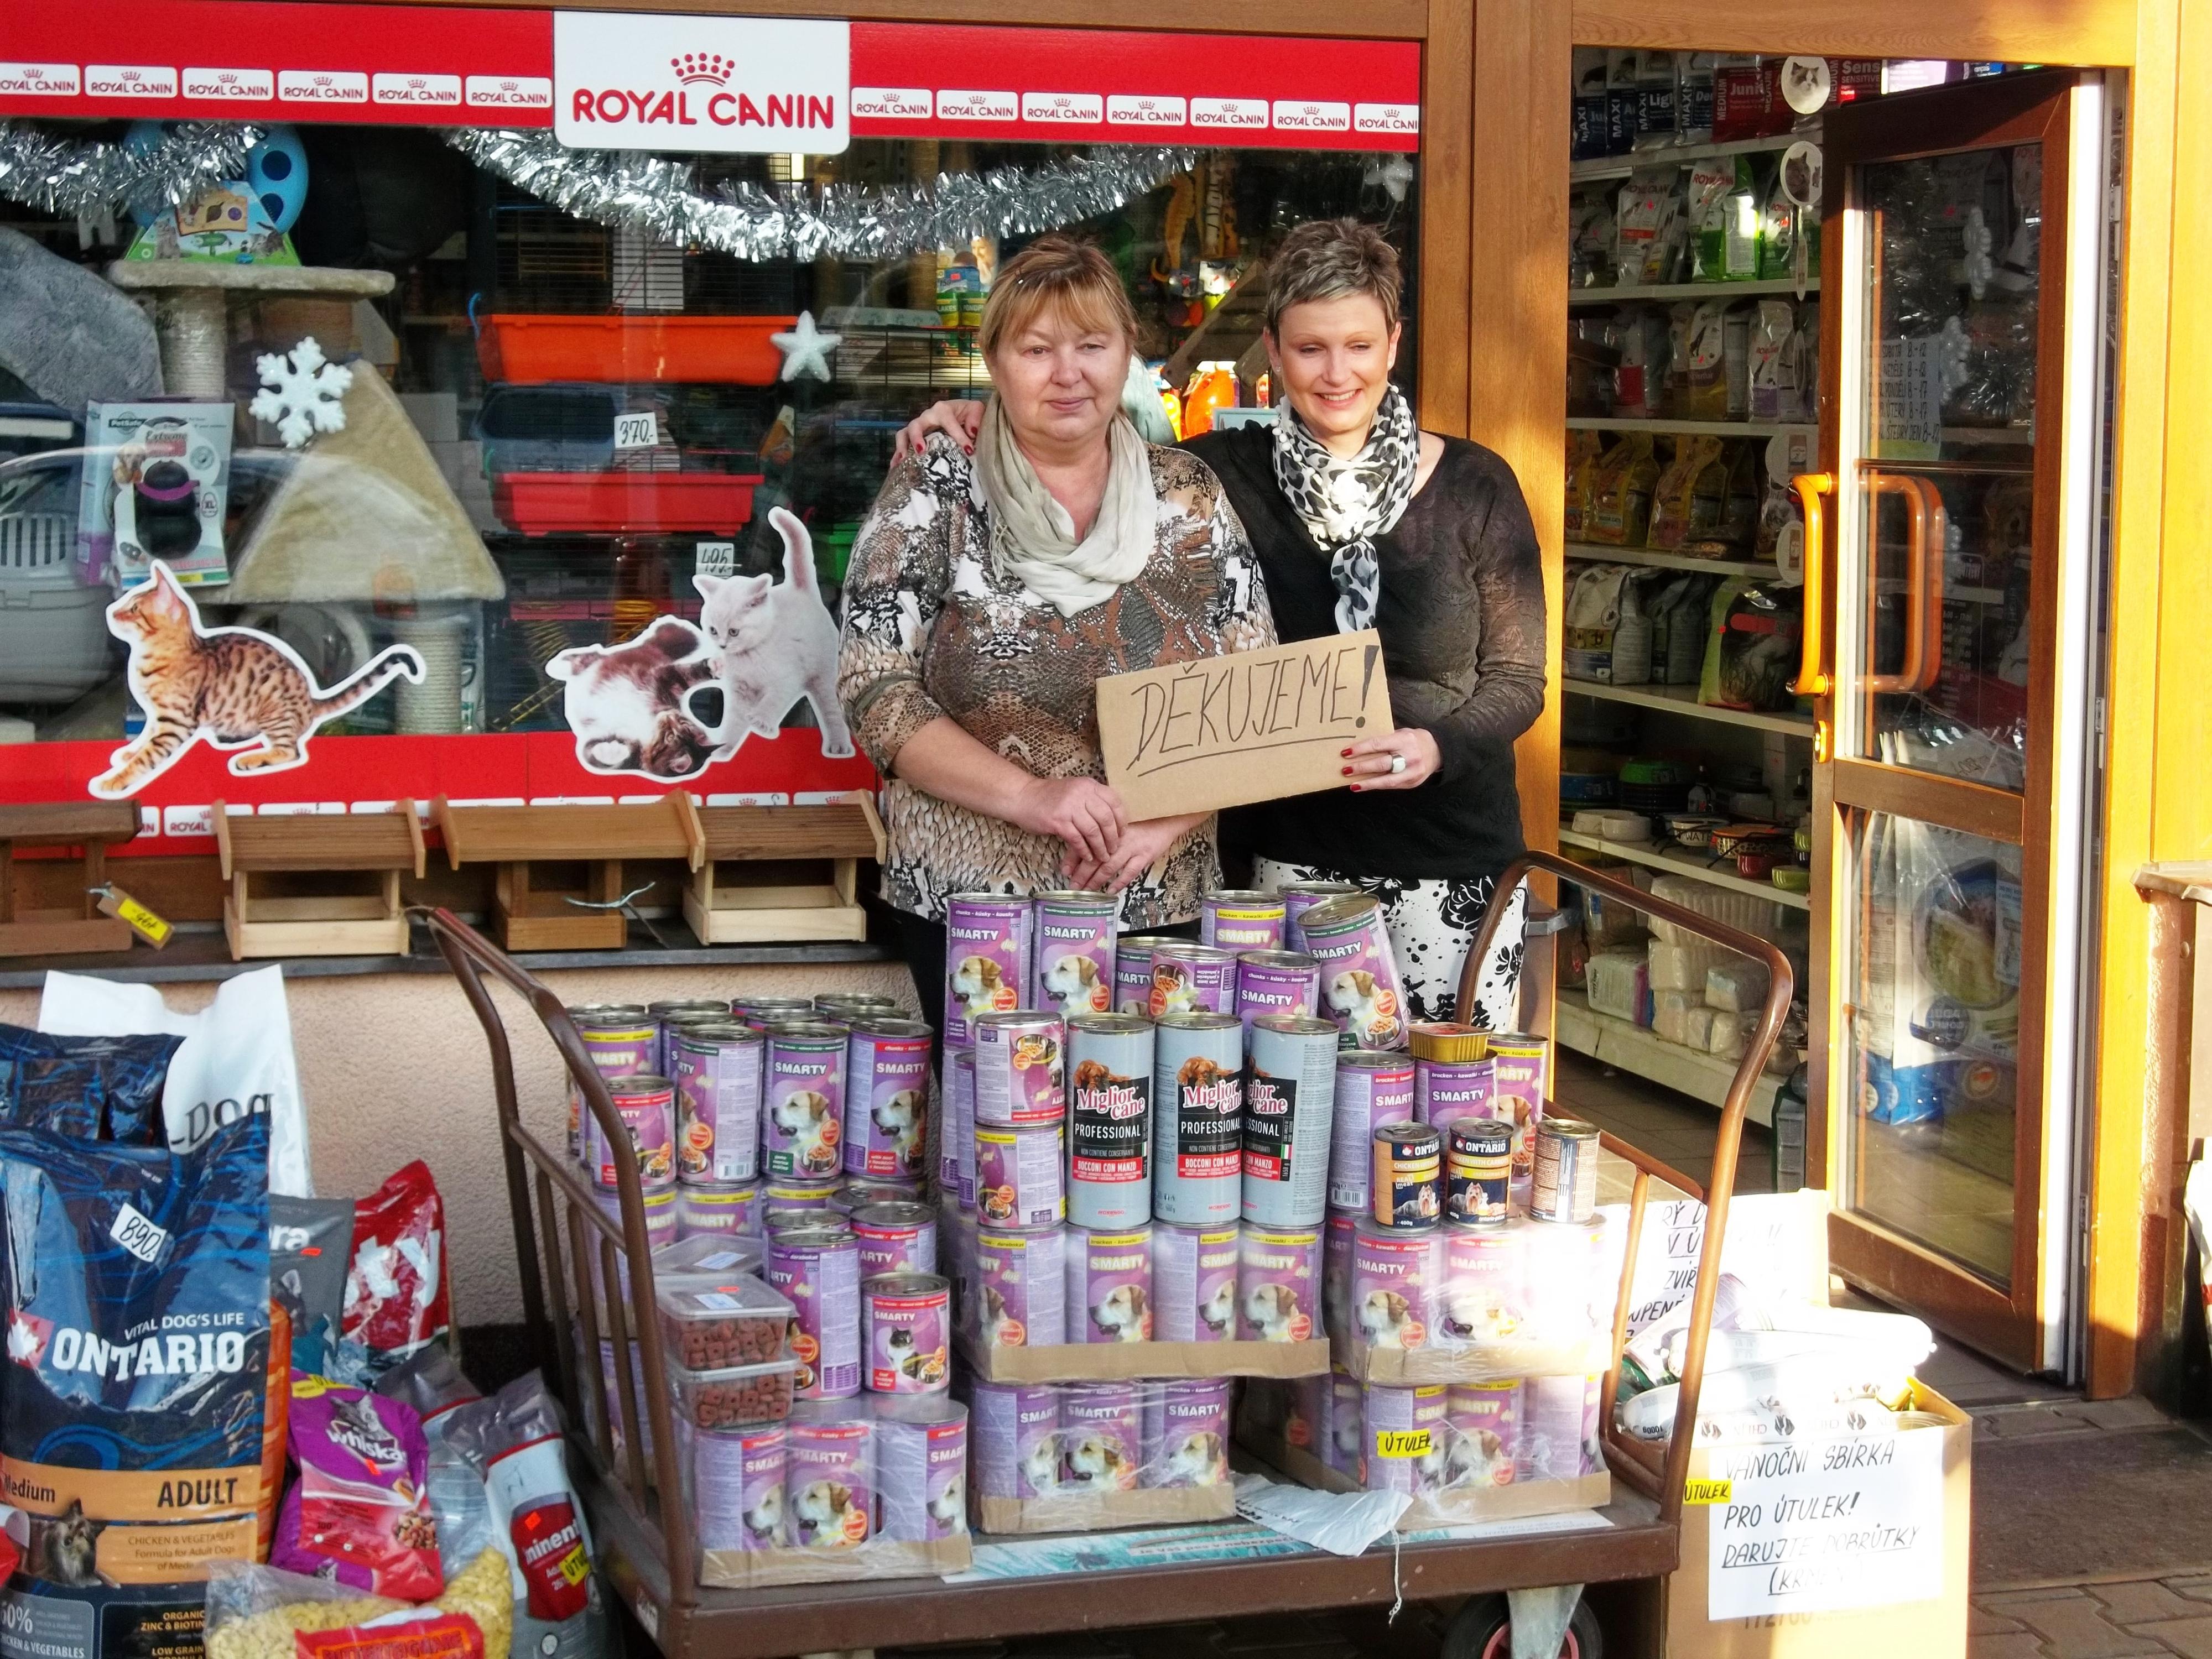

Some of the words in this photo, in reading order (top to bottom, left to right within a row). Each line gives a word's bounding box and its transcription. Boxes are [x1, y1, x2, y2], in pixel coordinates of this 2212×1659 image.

[0, 80, 31, 91] OYAL
[35, 81, 75, 91] CANIN
[1841, 75, 1880, 84] SENSITIVE
[91, 82, 129, 93] ROYAL
[133, 83, 173, 94] CANIN
[189, 85, 226, 95] ROYAL
[230, 86, 268, 96] CANIN
[284, 87, 321, 98] ROYAL
[325, 88, 363, 99] CANIN
[379, 90, 415, 100] ROYAL
[419, 91, 456, 101] CANIN
[472, 92, 507, 103] ROYAL
[511, 93, 547, 104] CANIN
[1716, 78, 1727, 121] MEDIUM
[572, 88, 697, 125] ROYAL
[707, 92, 834, 129] CANIN
[857, 103, 889, 113] ROYAL
[893, 105, 928, 114] CANIN
[942, 106, 975, 116] ROYAL
[979, 107, 1013, 117] CANIN
[1028, 108, 1061, 118] ROYAL
[1064, 109, 1098, 119] CANIN
[1638, 92, 1649, 131] MAXI
[1682, 88, 1693, 126] MAXI
[1112, 111, 1145, 121] ROYAL
[1148, 112, 1182, 122] CANIN
[1195, 113, 1228, 123] ROYAL
[1231, 114, 1264, 124] CANIN
[1278, 116, 1310, 126] ROYAL
[1313, 117, 1346, 127] CANIN
[1359, 119, 1391, 129] ROYAL
[1393, 120, 1417, 129] CANI
[1576, 106, 1590, 142] MAXI
[1611, 98, 1623, 138] MAXI
[1126, 644, 1380, 771] DĚKUJEME!
[170, 823, 206, 833] ROYAL
[1686, 831, 1711, 841] WATE
[951, 926, 999, 941] SMARTY
[1044, 925, 1097, 940] SMARTY
[1217, 927, 1271, 944] SMARTY
[1312, 940, 1362, 959] SMARTY
[1117, 971, 1151, 985] MARTY
[1241, 989, 1293, 1006] SMARTY
[774, 1061, 827, 1076] SMARTY
[876, 1062, 926, 1074] SMARTY
[1498, 1066, 1532, 1081] ARTY
[1076, 1085, 1136, 1114] Miglior
[1183, 1078, 1239, 1109] Miglior
[1248, 1084, 1276, 1105] glior
[1432, 1088, 1485, 1103] SMARTY
[1112, 1097, 1145, 1119] cane
[1253, 1097, 1288, 1114] cane
[1075, 1122, 1141, 1139] PROFESSIONAL
[1181, 1118, 1241, 1135] PROFESSIONAL
[1466, 1143, 1506, 1153] ONTARIO
[1078, 1162, 1101, 1172] BOCCONI
[1103, 1163, 1116, 1172] CON
[1117, 1162, 1137, 1171] MANZO
[1185, 1159, 1211, 1168] BOCCONI
[1213, 1159, 1224, 1168] CON
[1254, 1159, 1272, 1170] MANZO
[270, 1225, 310, 1251] ra
[861, 1250, 892, 1263] ARTY
[1090, 1255, 1144, 1271] SMARTY
[1357, 1258, 1406, 1275] SMARTY
[874, 1311, 915, 1322] SMARTY
[124, 1318, 158, 1340] VITAL
[162, 1313, 210, 1329] DOG'S
[214, 1312, 244, 1326] LIFE
[53, 1327, 244, 1381] ONTARIO
[1067, 1405, 1121, 1418] SMARTY
[1168, 1404, 1220, 1417] SMARTY
[1385, 1432, 1432, 1453] ÚTULEK
[1726, 1442, 1814, 1481] VÁNOČNÍ
[1824, 1438, 1894, 1471] SBÍRKA
[157, 1477, 238, 1508] ADULT
[1684, 1480, 1729, 1502] ÚTULEK
[1724, 1503, 1761, 1530] PRO
[1774, 1491, 1861, 1524] ÚTULEK!
[128, 1535, 171, 1546] CHICKEN
[173, 1535, 180, 1545] &
[181, 1532, 235, 1545] VEGETABLES
[135, 1549, 172, 1558] Formula
[174, 1549, 186, 1557] for
[189, 1546, 214, 1556] Adult
[215, 1545, 235, 1557] Dogs
[1722, 1537, 1814, 1567] DARUJTE
[157, 1561, 166, 1570] of
[163, 1610, 205, 1621] ORGANIC
[140, 1620, 164, 1631] ZINC
[165, 1621, 173, 1630] &
[174, 1619, 205, 1630] BIOTIN
[30, 1641, 85, 1659] VEGETABLES
[152, 1647, 172, 1656] LOW
[174, 1645, 204, 1655] GRAIN
